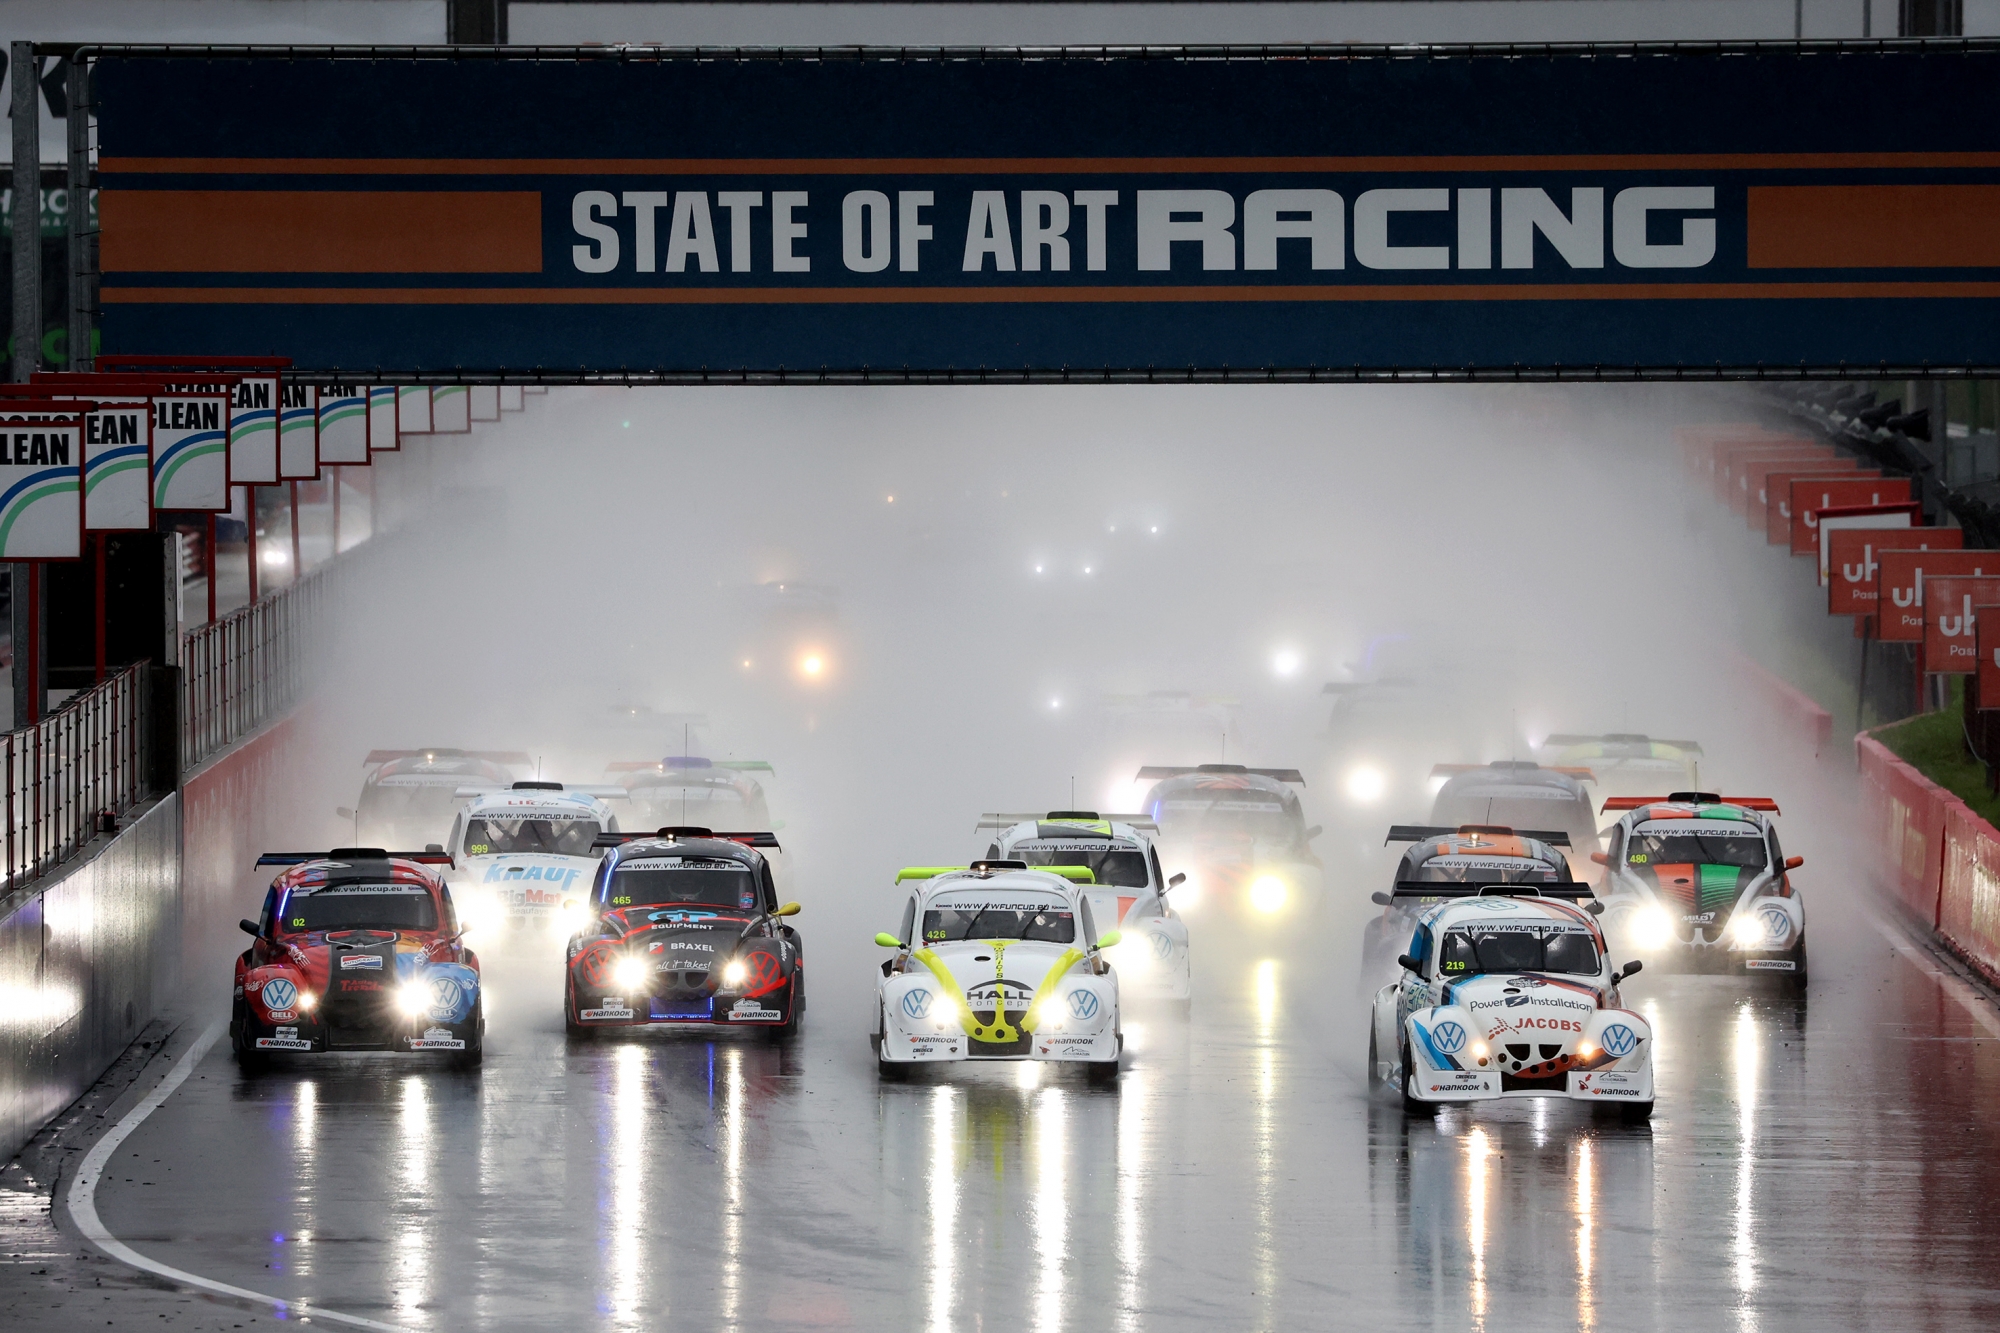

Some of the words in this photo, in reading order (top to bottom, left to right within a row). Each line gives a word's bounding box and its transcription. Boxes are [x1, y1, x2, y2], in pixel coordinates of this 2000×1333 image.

[572, 190, 811, 274] STATE
[842, 190, 934, 273] OF
[962, 190, 1118, 272] ART
[1137, 186, 1716, 271] RACING
[471, 844, 488, 854] 999
[1630, 854, 1648, 863] 480
[613, 896, 631, 905] 465
[293, 918, 306, 927] 02
[651, 922, 714, 930] EQUIPMENT
[927, 930, 946, 939] 426
[671, 942, 715, 953] BRAXEL
[656, 961, 670, 970] all
[672, 960, 683, 969] it
[684, 959, 712, 970] takes!
[1446, 961, 1466, 970] 219
[967, 990, 1032, 1000] HALL
[1470, 998, 1504, 1013] Power
[1530, 996, 1593, 1015] Installation
[1515, 1017, 1582, 1033] JACOBS
